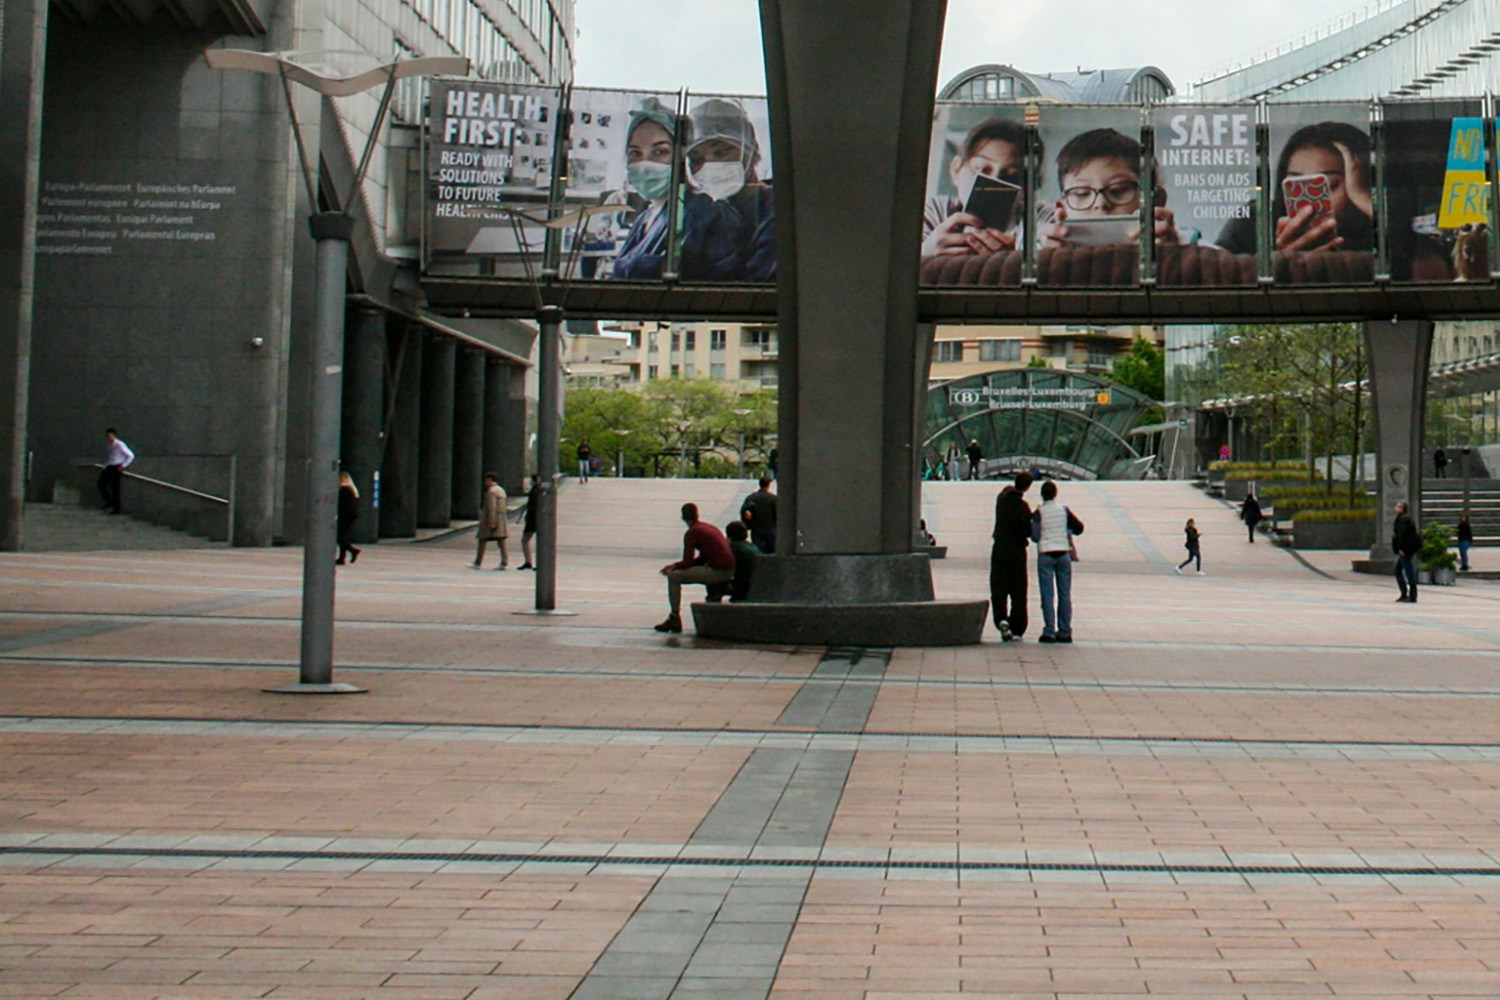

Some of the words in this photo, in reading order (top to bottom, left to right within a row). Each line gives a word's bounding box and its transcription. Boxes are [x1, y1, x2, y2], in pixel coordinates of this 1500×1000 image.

[446, 90, 541, 120] HEALTH
[444, 117, 522, 146] FIRST:
[1170, 114, 1248, 146] SAFE
[1453, 127, 1481, 163] NO
[441, 151, 481, 166] READY
[482, 153, 514, 168] WITH
[1162, 148, 1249, 166] INTERNET:
[440, 169, 505, 185] SOLUTIONS
[1174, 173, 1206, 186] BANS
[1207, 173, 1225, 186] ON
[1227, 173, 1250, 186] ADS
[438, 185, 453, 199] TO
[455, 186, 501, 201] FUTURE
[1186, 188, 1250, 202] TARGETING
[1193, 205, 1250, 218] CHILDREN
